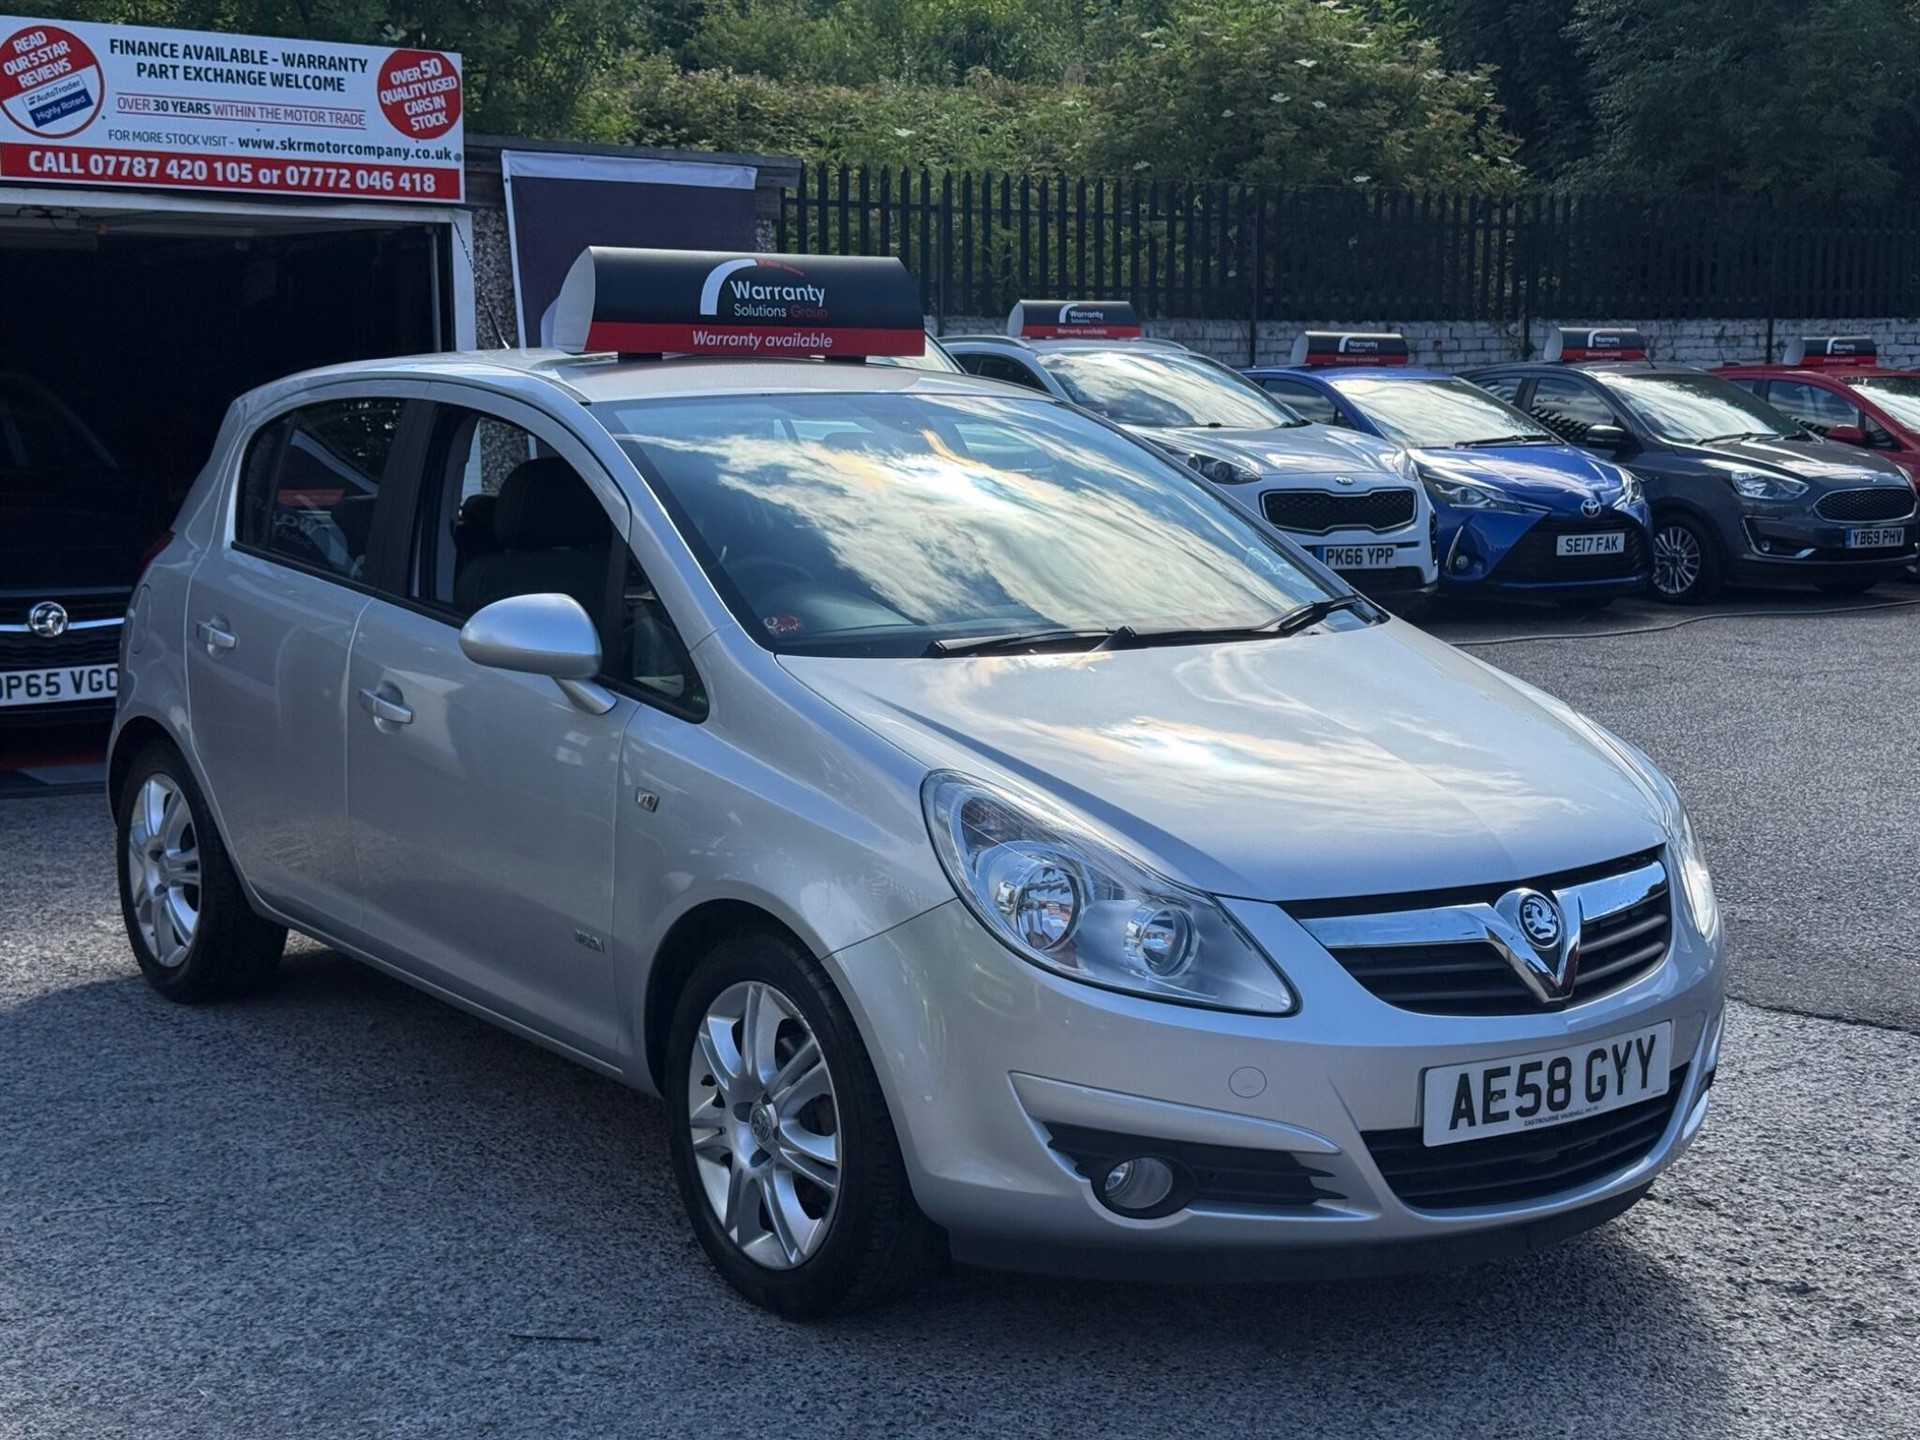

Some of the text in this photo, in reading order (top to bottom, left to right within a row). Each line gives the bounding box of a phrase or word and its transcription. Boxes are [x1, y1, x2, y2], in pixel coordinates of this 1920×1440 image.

[12, 31, 47, 54] READ
[109, 38, 179, 59] FINANCE
[182, 44, 269, 66] AVAILABLE
[281, 51, 368, 74] WARRANTY
[3, 40, 71, 76] OUR 5 STAR
[390, 58, 442, 85] OVER 50
[17, 58, 72, 88] REVIEWS
[136, 62, 345, 92] PART EXCHANGE WELCOME
[36, 80, 80, 102] AutoTrader
[380, 75, 457, 105] QUALITY USED
[36, 95, 86, 121] Highly Rated
[117, 96, 365, 126] OVER 30 YEARS WITHIN THE MOTOR TRADE
[404, 94, 446, 116] CARS IN
[410, 111, 448, 132] STOCK
[108, 129, 130, 142] FOR
[132, 131, 163, 144] MORE
[165, 132, 199, 146] STOCK
[201, 134, 228, 147] VISIT
[238, 137, 452, 161] www.skrmotorcompany.co.uk
[29, 150, 436, 193] CALL 07787 420 105 or 07772 046 418
[729, 280, 825, 307] Warranty
[734, 303, 828, 320] Solutions Group
[1069, 310, 1104, 320] Warranty
[692, 330, 833, 350] Warranty available
[1565, 536, 1619, 553] SE17 FAK
[1852, 529, 1903, 546] YB69 PHV
[1326, 547, 1394, 565] PK66 YPP
[0, 672, 61, 700] P65
[1448, 1034, 1656, 1130] AE58 GYY
